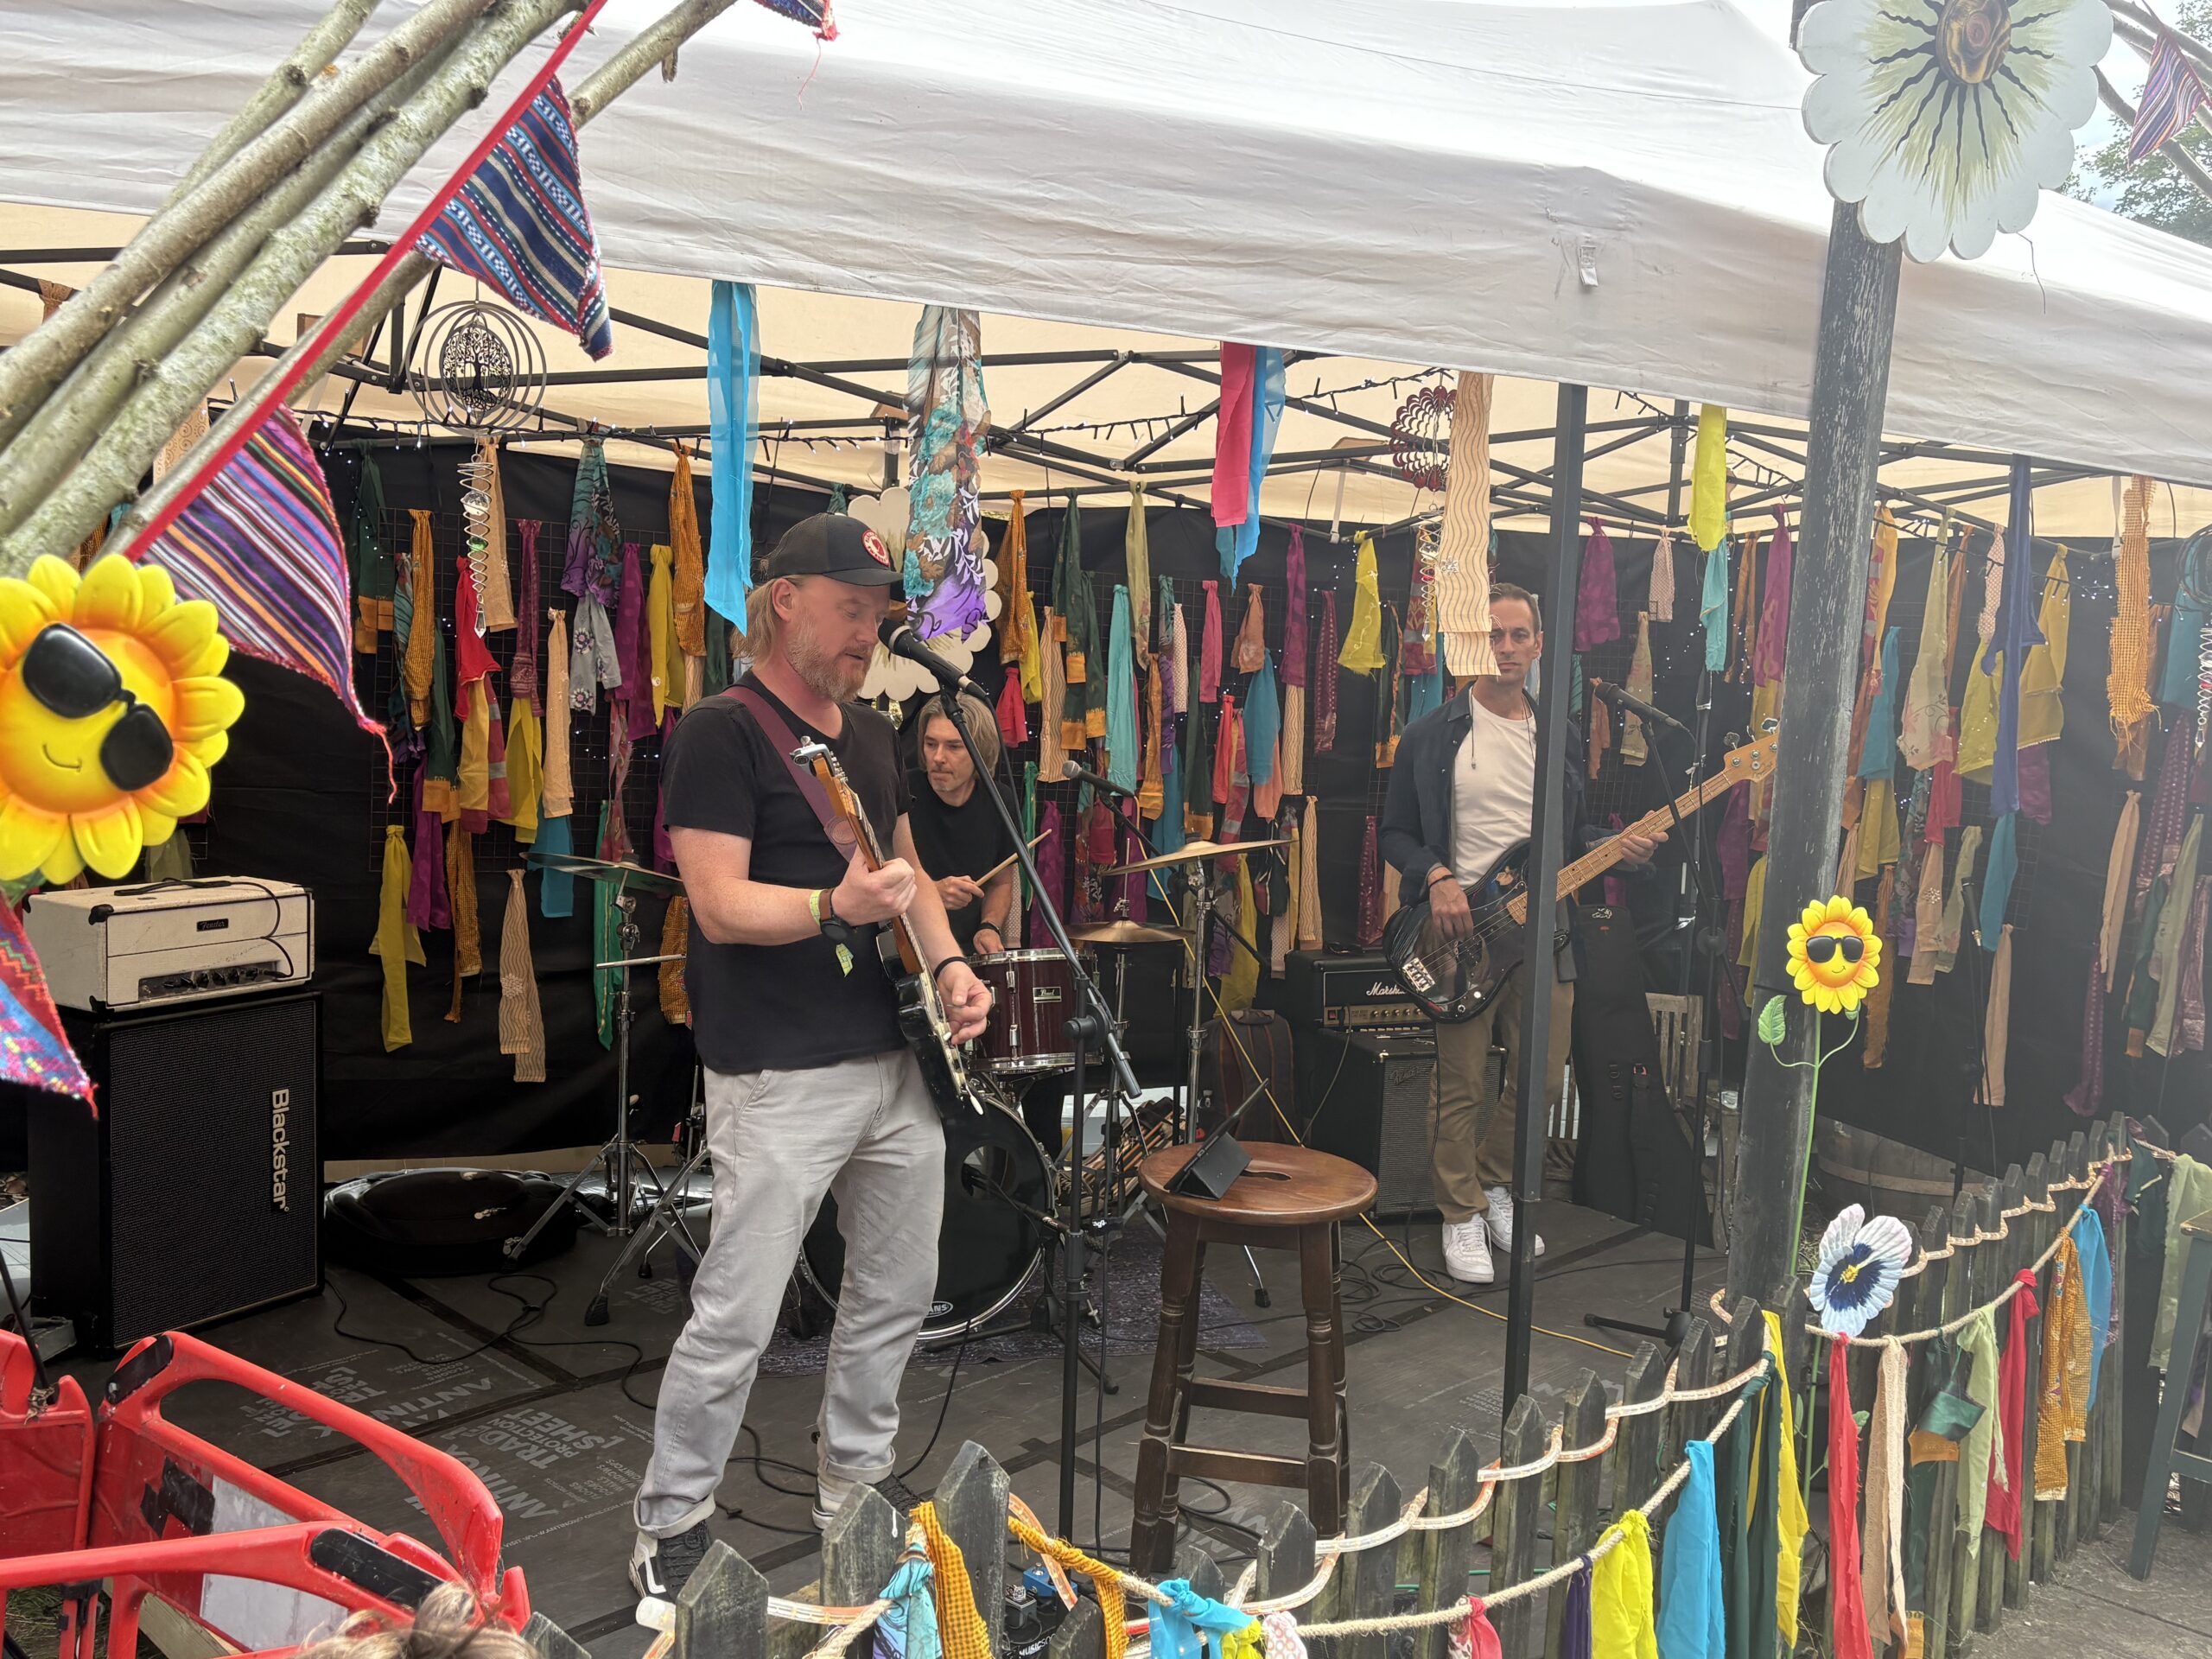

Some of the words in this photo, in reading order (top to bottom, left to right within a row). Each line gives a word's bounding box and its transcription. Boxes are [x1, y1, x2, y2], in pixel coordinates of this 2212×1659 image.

[272, 1089, 289, 1210] Blackstar
[308, 1377, 492, 1438] ANTINX
[503, 1408, 605, 1449] SHEET
[461, 1425, 560, 1469] TRADE
[486, 1418, 580, 1458] PROTECTION
